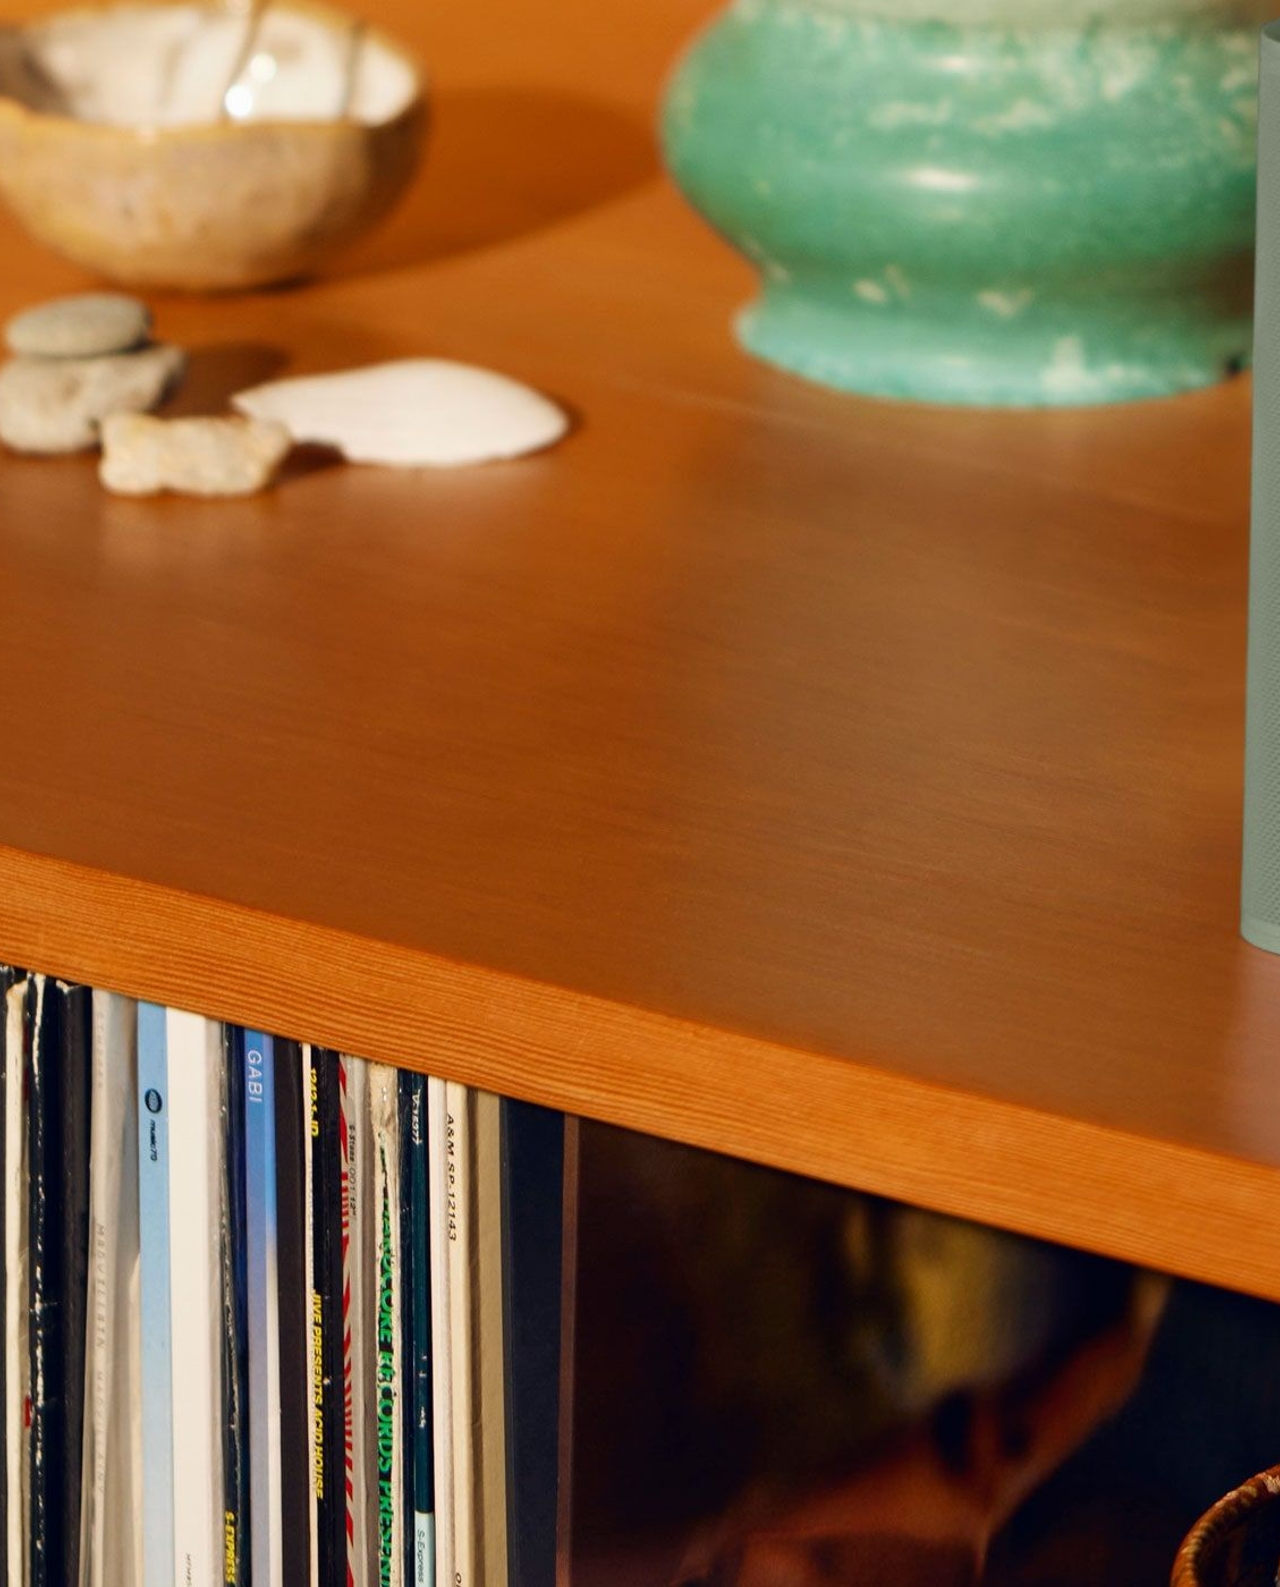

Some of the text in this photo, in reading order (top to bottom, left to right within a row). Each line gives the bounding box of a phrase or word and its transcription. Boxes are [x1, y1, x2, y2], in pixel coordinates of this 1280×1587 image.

[248, 1049, 262, 1103] GABI
[447, 1114, 455, 1156] A&M
[313, 1293, 324, 1500] JIVE PRESENTS ACID HOUSE
[377, 1350, 395, 1473] RECORDS
[224, 1510, 236, 1584] S-EXPRESS
[417, 1529, 425, 1584] S-Express
